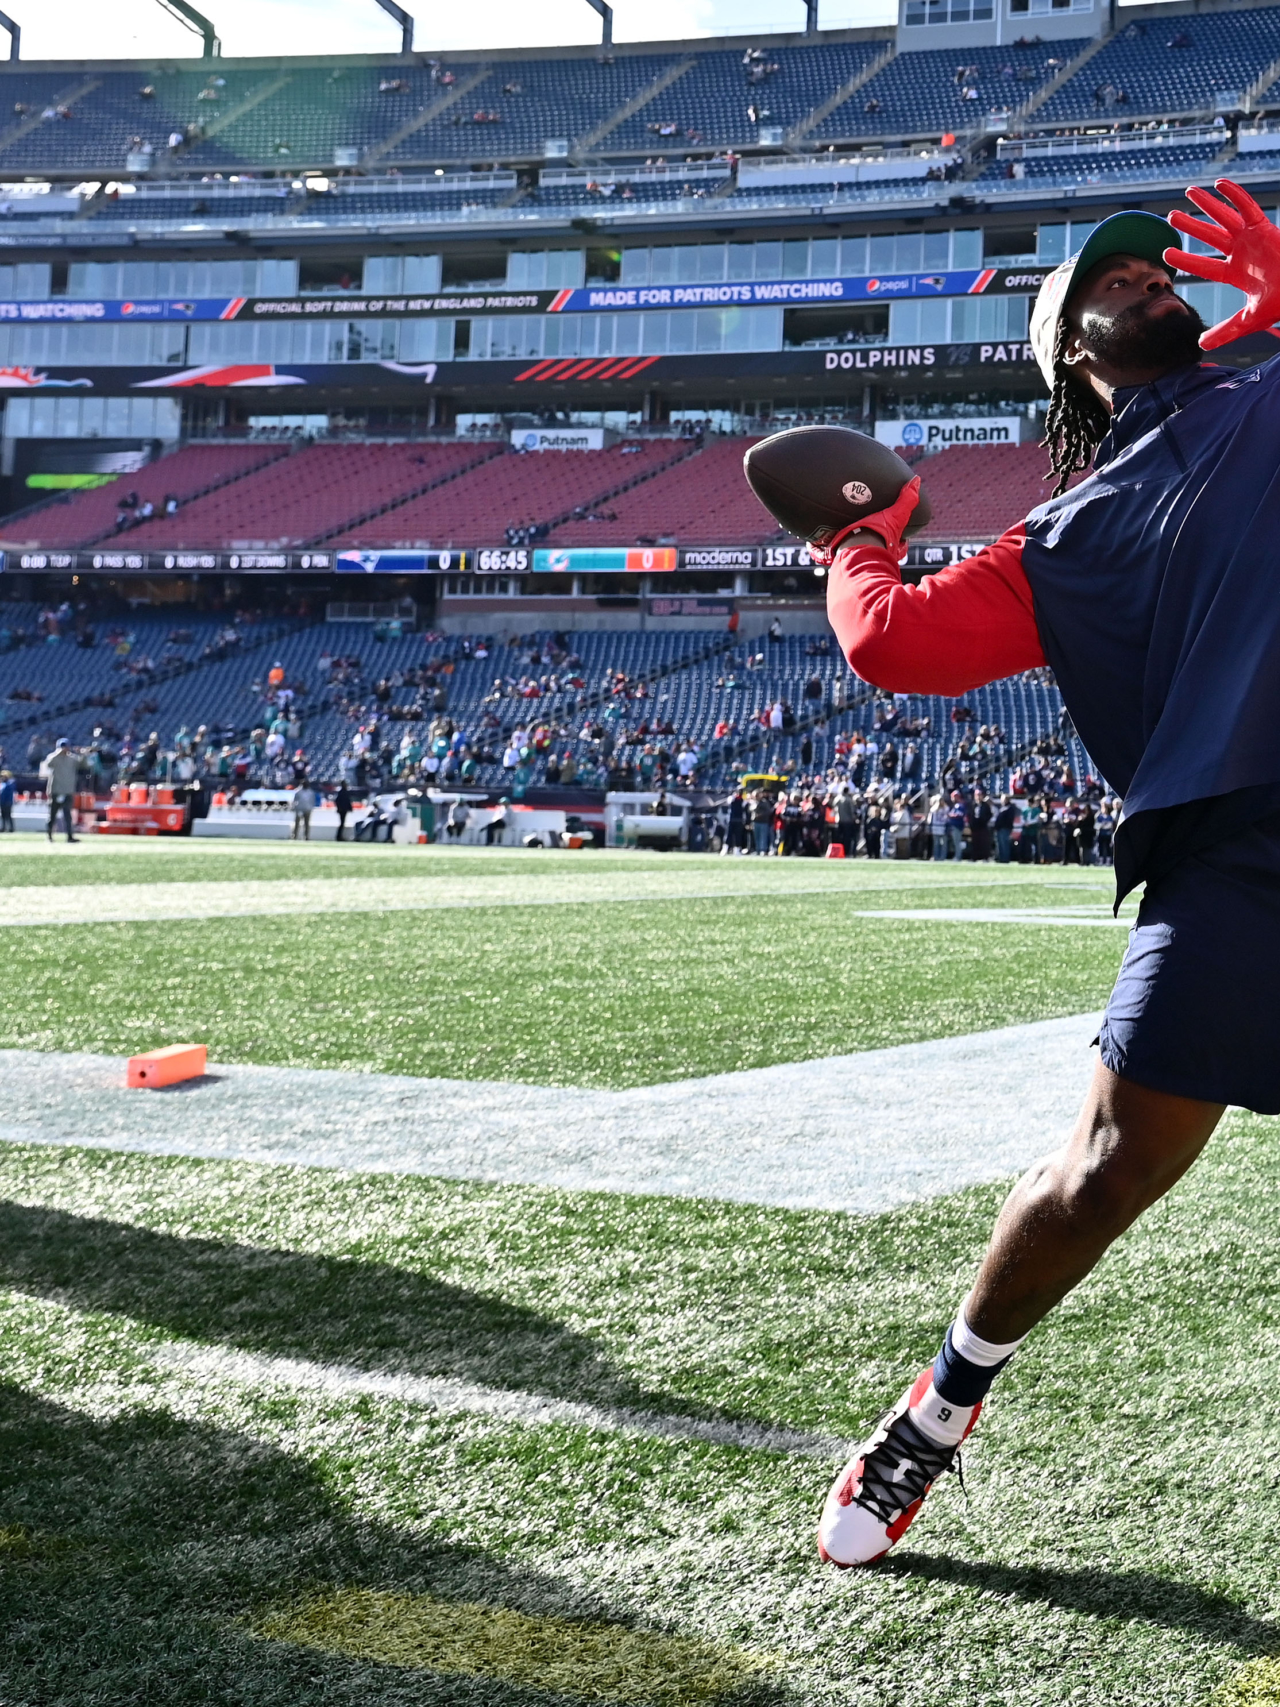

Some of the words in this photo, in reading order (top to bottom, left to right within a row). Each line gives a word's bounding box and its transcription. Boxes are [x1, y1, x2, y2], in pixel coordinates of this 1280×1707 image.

[589, 291, 636, 306] MADE
[639, 288, 672, 304] FOR
[674, 284, 752, 303] PATRIOTS
[754, 281, 844, 300] WATCHING
[880, 279, 909, 293] pepsi
[21, 302, 105, 319] WATCHING
[254, 302, 301, 314] OFFICIAL
[305, 301, 333, 313] SOFT
[333, 300, 368, 313] DRINK
[369, 300, 385, 312] OF
[386, 299, 406, 312] THE
[407, 298, 432, 311] NEW
[434, 296, 484, 310] ENGLAND
[486, 295, 538, 309] PATRIOTS
[825, 348, 936, 370] DOLPHINS
[980, 343, 1034, 362] PATR
[540, 435, 590, 448] Putnam
[928, 424, 1010, 445] Putnam
[851, 482, 867, 496] 204
[93, 554, 103, 569] 0
[164, 555, 175, 569] 0
[229, 555, 240, 569] 0
[301, 555, 311, 569] 0
[439, 550, 451, 569] 0
[479, 551, 528, 570] 66:45
[641, 550, 654, 569] 0
[685, 549, 752, 565] moderna
[765, 547, 797, 567] 1ST
[924, 548, 944, 563] QTR
[937, 1407, 952, 1422] 9
